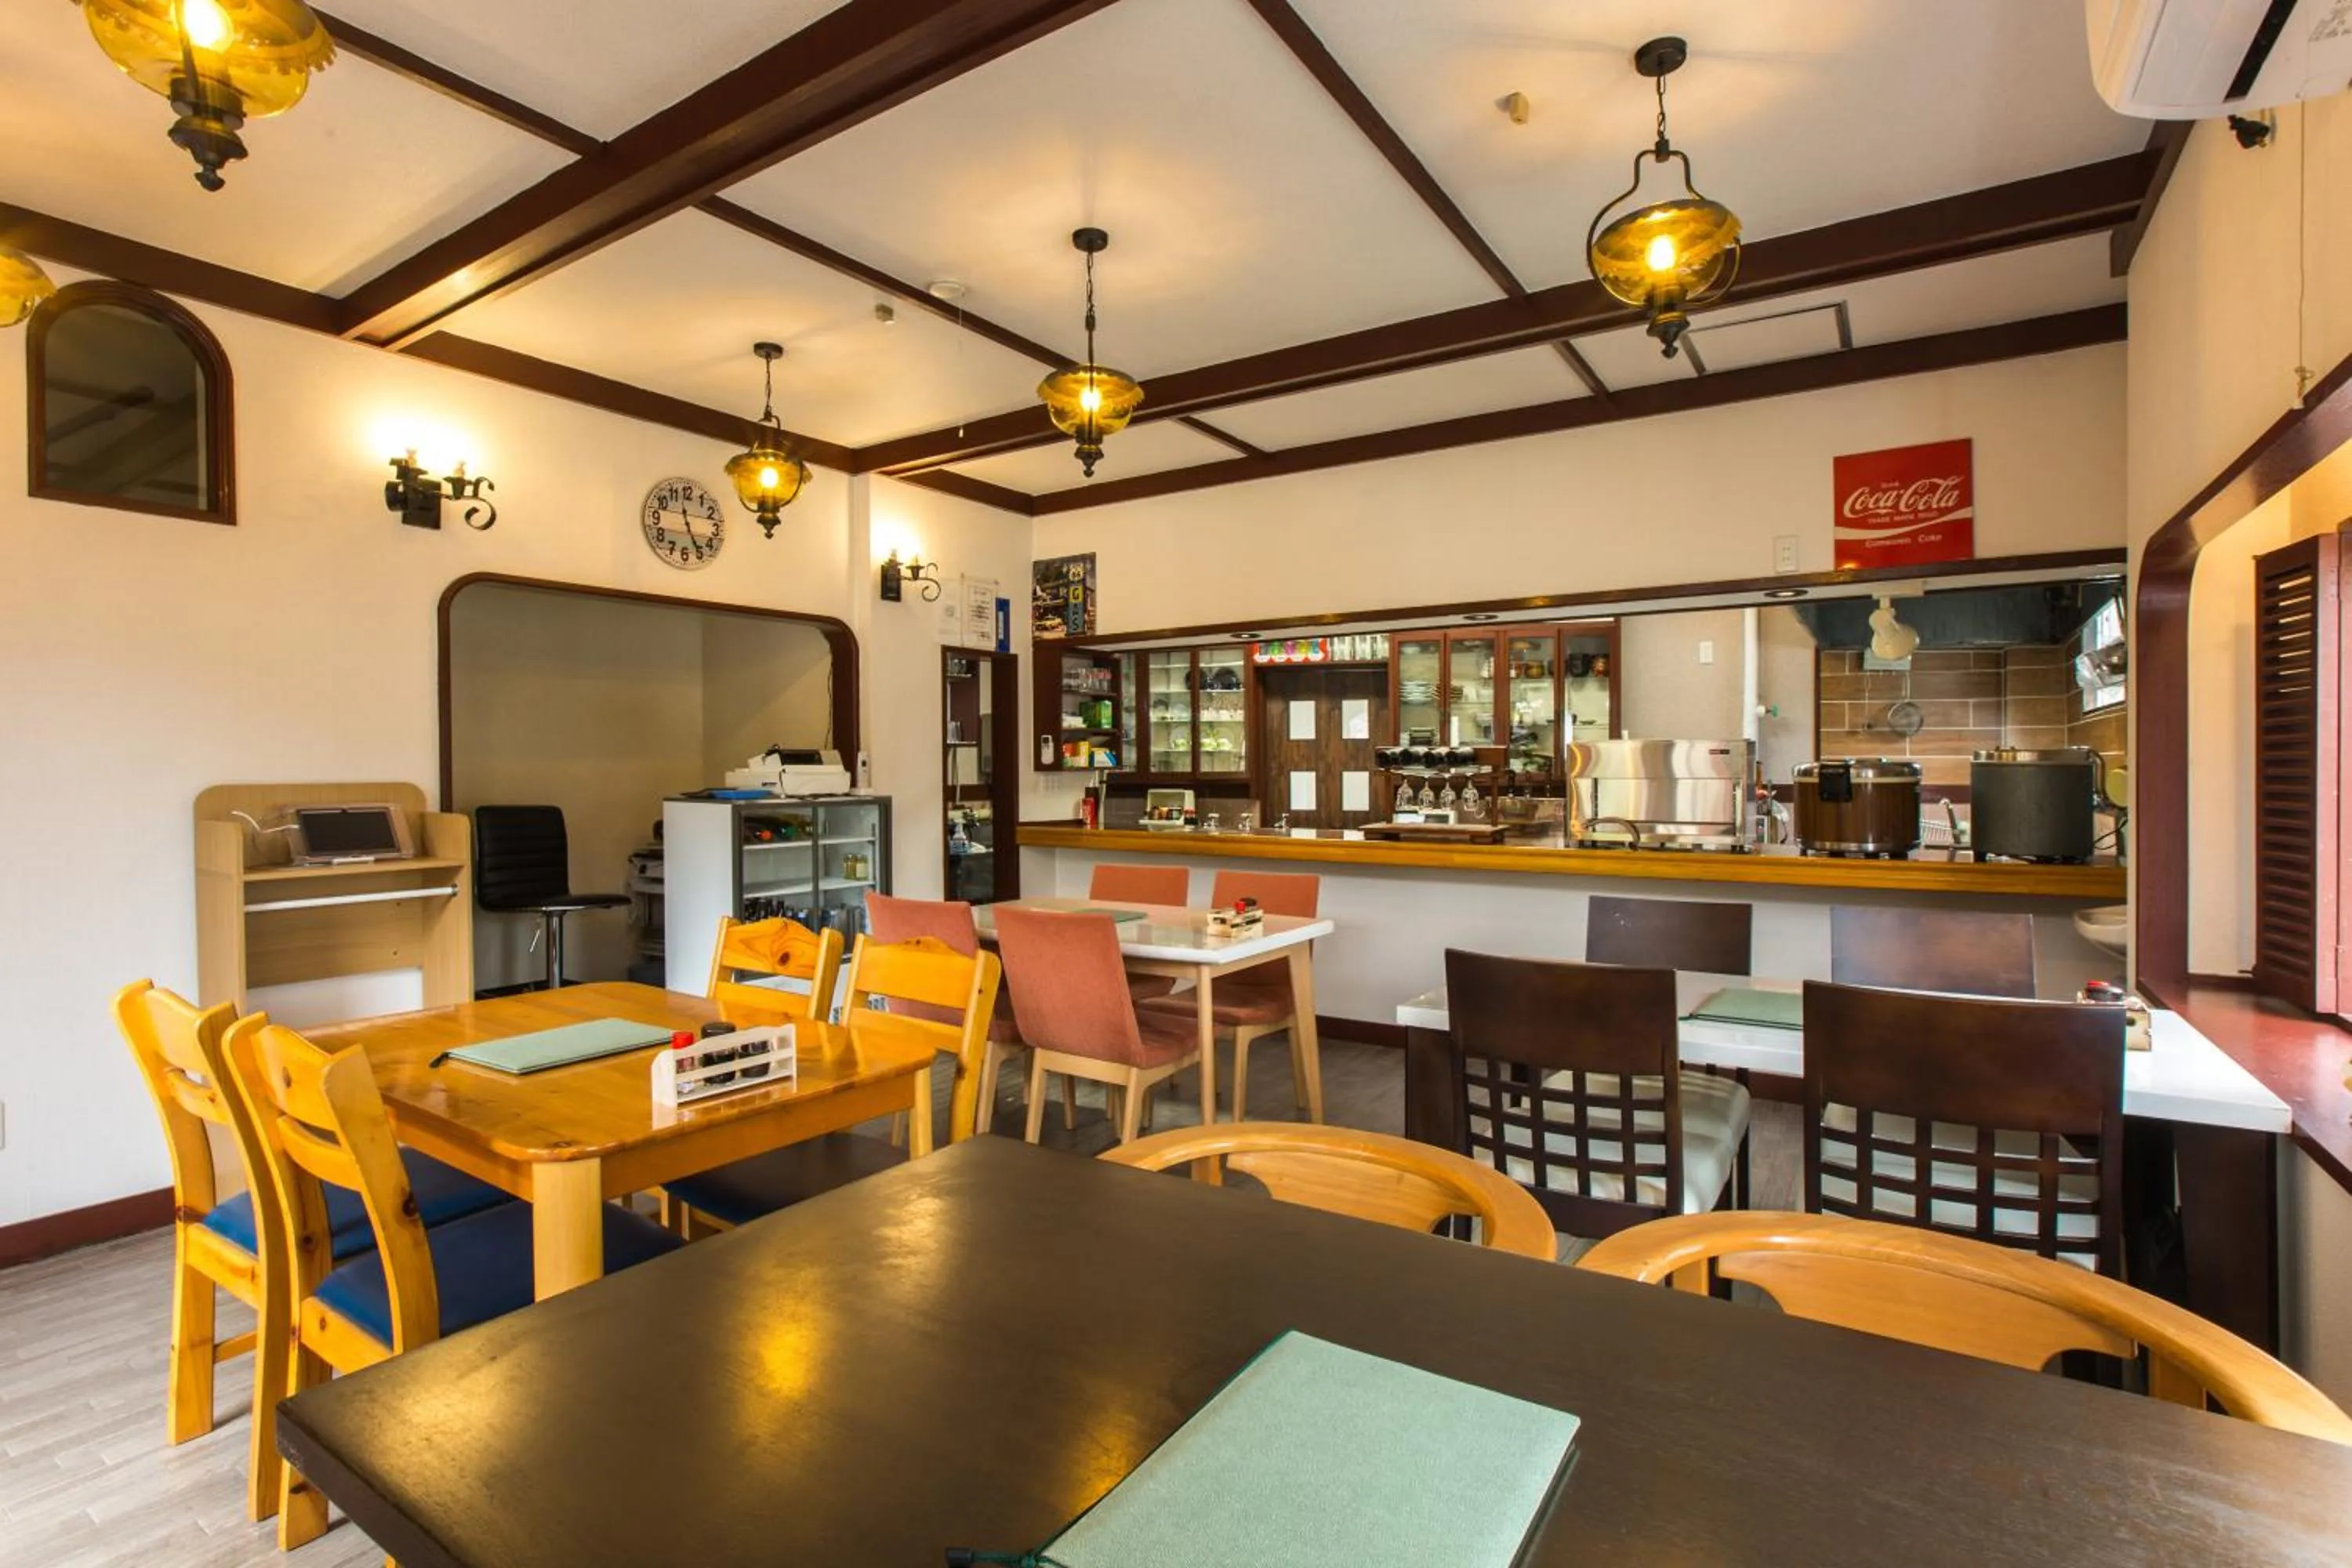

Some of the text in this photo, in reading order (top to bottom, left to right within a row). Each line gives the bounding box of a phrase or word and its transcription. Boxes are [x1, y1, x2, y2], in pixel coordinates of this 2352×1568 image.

[669, 487, 678, 502] 11
[681, 485, 693, 501] 12
[699, 493, 704, 507] 1
[1843, 475, 1965, 518] Coca-Cola
[657, 495, 668, 510] 10
[652, 510, 660, 525] 9
[707, 506, 715, 519] 2
[656, 527, 665, 543] 8
[711, 523, 719, 536] 3
[667, 541, 677, 555] 7
[706, 538, 713, 551] 4
[681, 547, 689, 561] 6
[695, 545, 703, 560] 5
